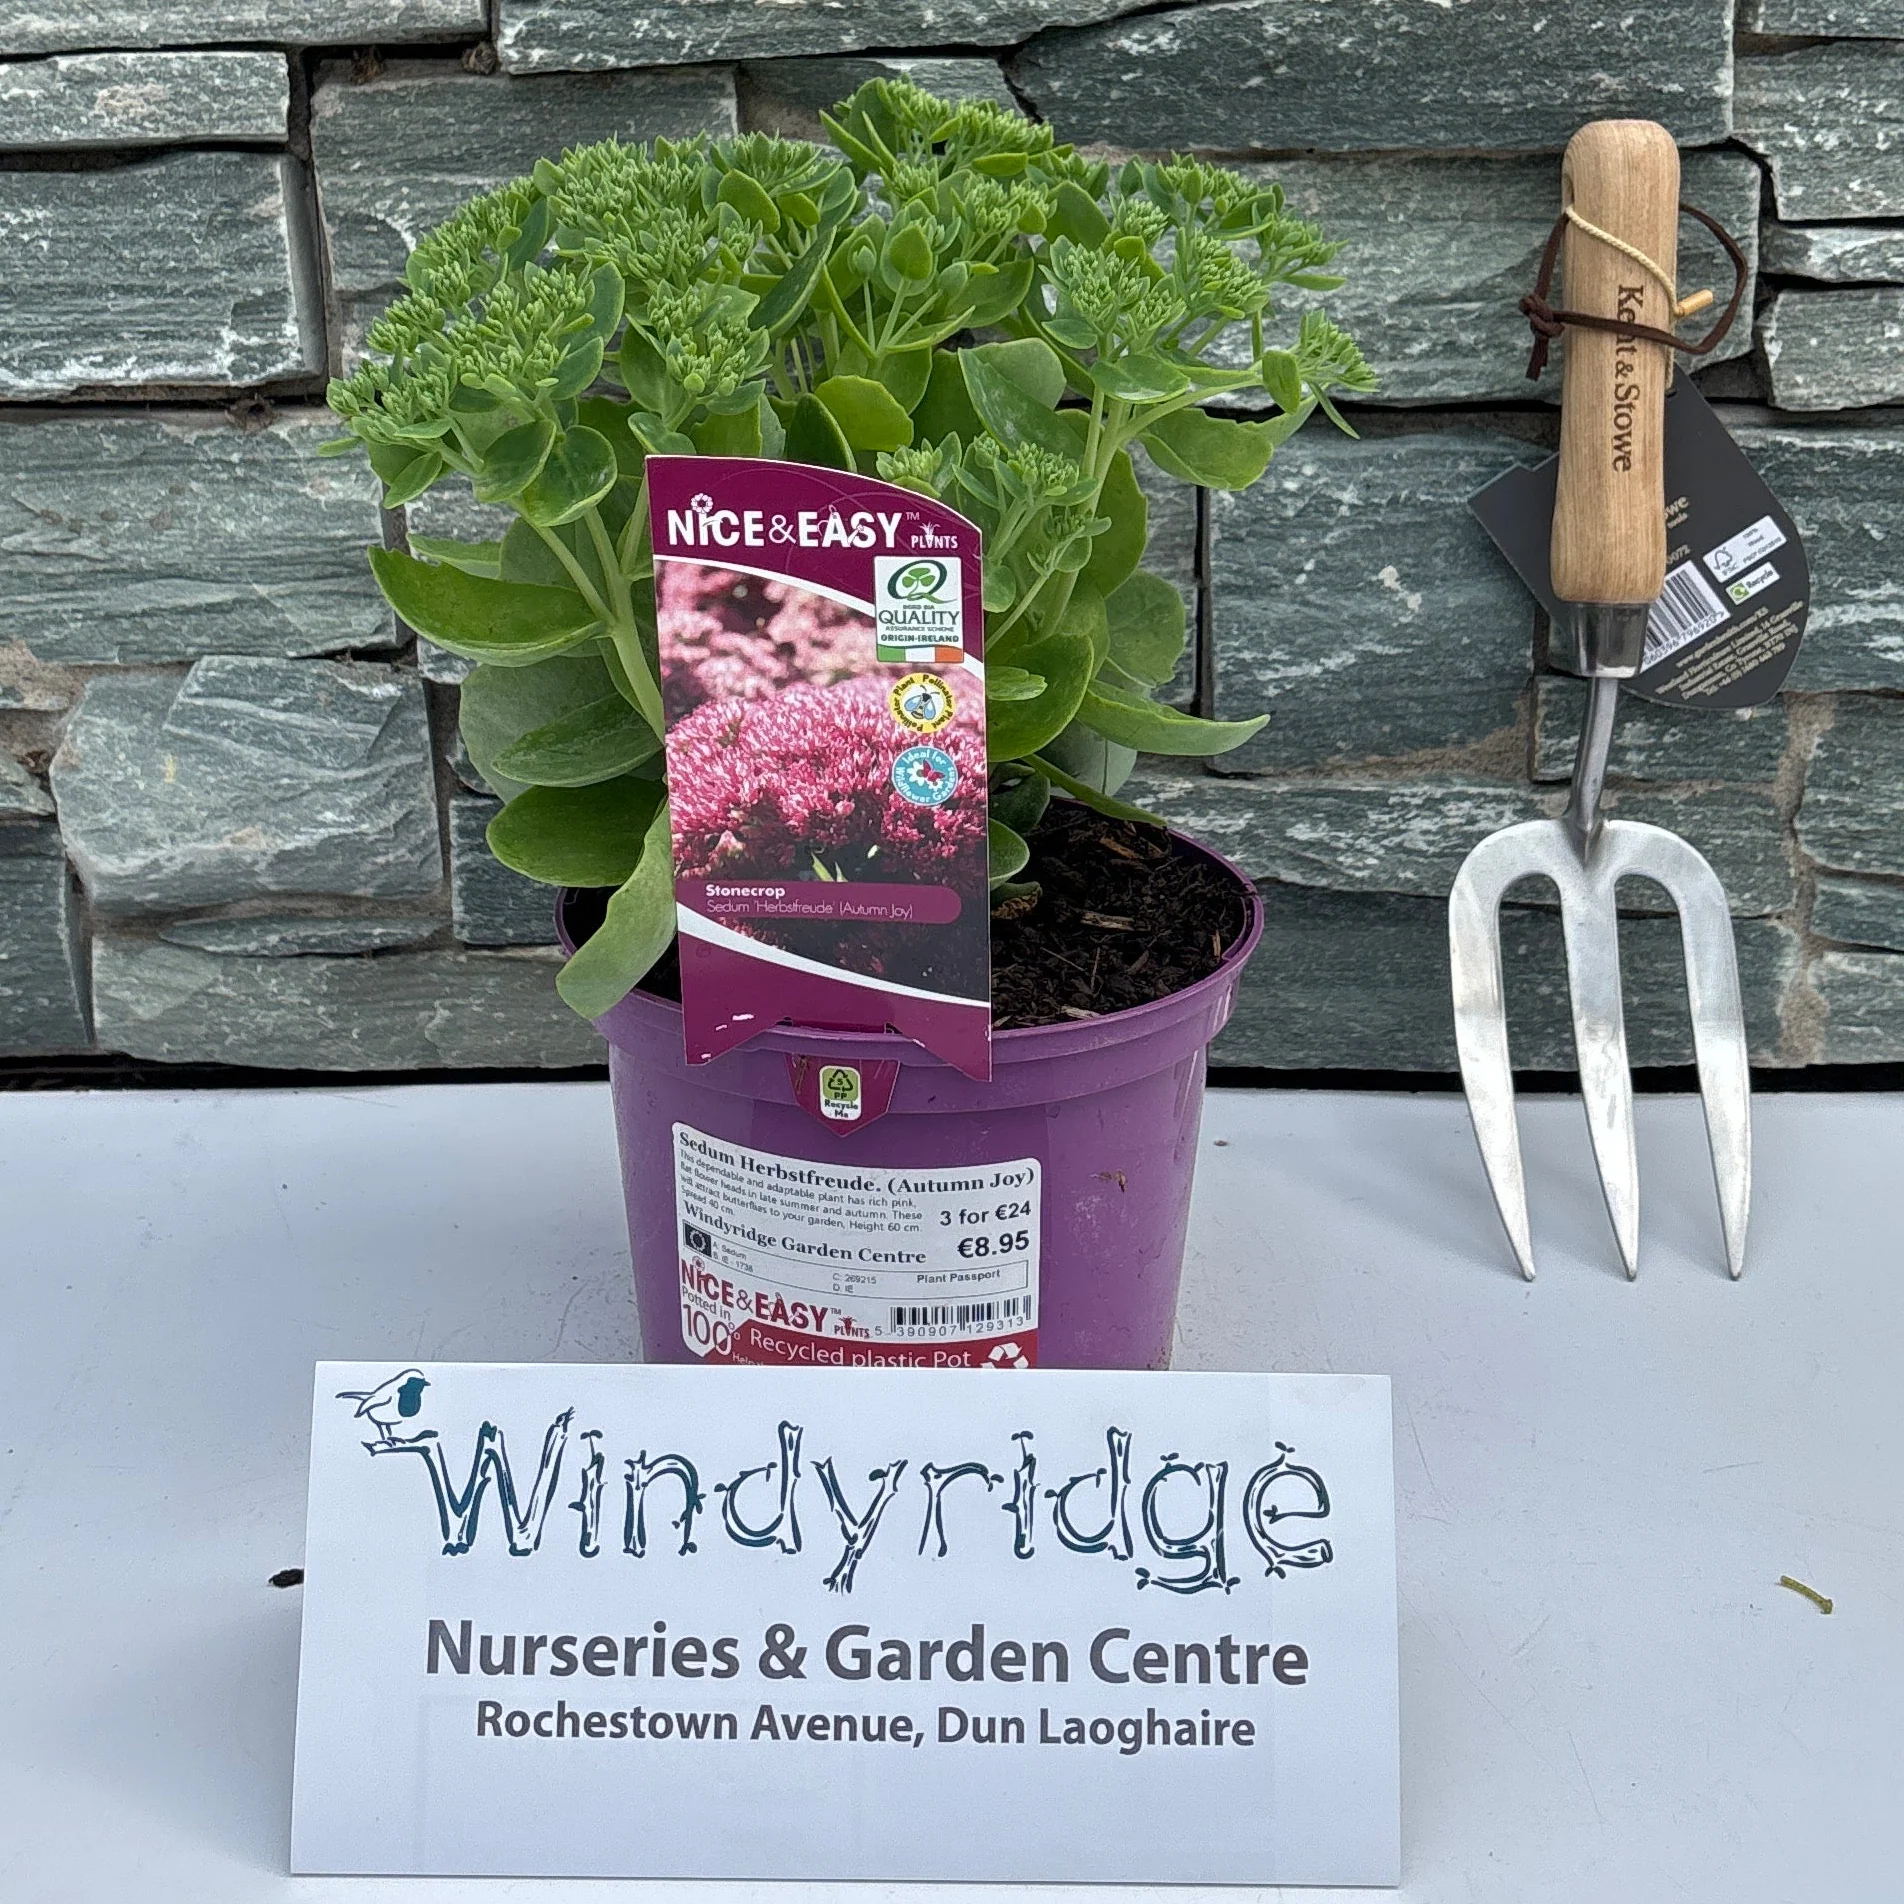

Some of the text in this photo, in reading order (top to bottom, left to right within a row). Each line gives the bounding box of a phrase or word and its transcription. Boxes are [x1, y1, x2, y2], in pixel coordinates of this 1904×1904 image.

[1614, 361, 1635, 380] &
[1611, 384, 1641, 473] Stowe
[1745, 569, 1774, 589] Recycle
[878, 609, 960, 625] QUALITY
[705, 884, 785, 898] Stonecrop
[707, 900, 750, 913] Sedum
[839, 902, 888, 916] (Autumn
[889, 902, 914, 919] Joy)
[824, 1098, 859, 1110] Recycle
[834, 1091, 848, 1100] PP
[834, 1110, 849, 1118] Me
[680, 1131, 1035, 1196] Sedum Herbstfreude. (Autumn Joy)
[680, 1150, 695, 1164] This
[695, 1159, 745, 1183] dependable
[747, 1177, 764, 1188] and
[766, 1183, 815, 1200] adaptable
[818, 1191, 844, 1204] plant
[847, 1194, 865, 1205] has
[868, 1196, 888, 1207] rich
[694, 1168, 719, 1186] flower
[720, 1179, 747, 1196] heads
[747, 1189, 757, 1199] in
[759, 1192, 777, 1205] late
[779, 1198, 821, 1213] summer
[822, 1205, 842, 1216] and
[892, 1210, 923, 1220] These
[694, 1180, 721, 1200] attract
[769, 1206, 781, 1217] to
[782, 1211, 805, 1222] your
[849, 1219, 885, 1232] Height
[887, 1222, 901, 1232] 60
[708, 1197, 720, 1210] 40
[939, 1200, 1032, 1226] 3 for €24
[683, 1199, 927, 1264] Windyridge Garden Centre
[957, 1229, 1030, 1259] €8.95
[916, 1269, 1001, 1284] Plant Passport
[681, 1285, 731, 1322] Potted in
[874, 1315, 1024, 1337] 5 390907 129313
[749, 1327, 972, 1367] Recycled plastic Pot
[405, 1405, 1334, 1596] Windyridge
[425, 1618, 1311, 1687] Nurseries & Garden Centre
[476, 1700, 1256, 1756] Rochestown Avenue, Dun Laoghaire
